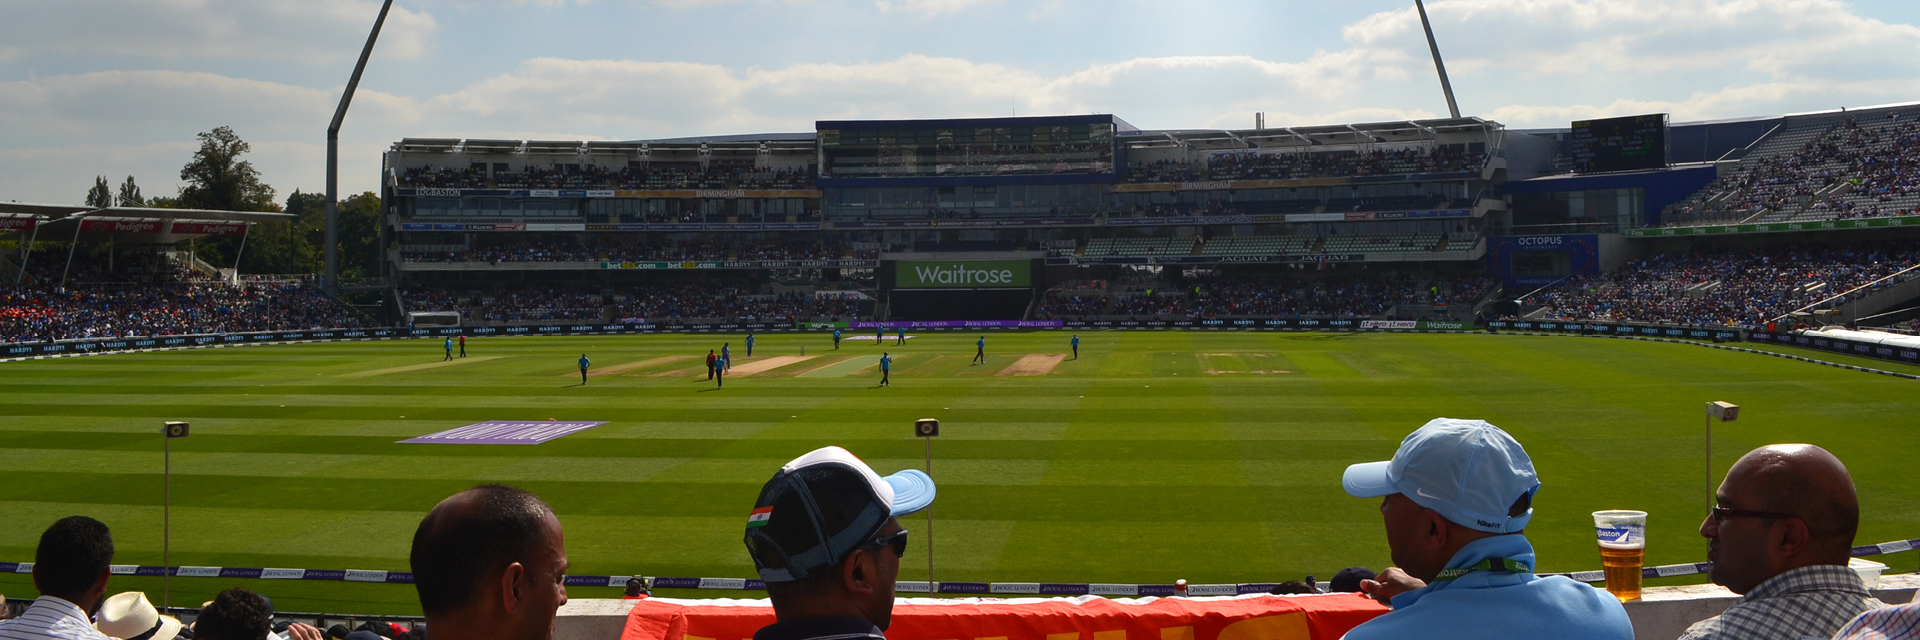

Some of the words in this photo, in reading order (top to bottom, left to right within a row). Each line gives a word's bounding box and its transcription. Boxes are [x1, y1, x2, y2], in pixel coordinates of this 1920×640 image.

[1181, 182, 1232, 190] BIRMINGHAM
[115, 222, 154, 233] Pedigree
[202, 224, 239, 235] Pedigree
[1518, 236, 1562, 245] OCTOPUS
[915, 264, 1013, 284] Waitrose
[1476, 519, 1501, 530] NikeFIT
